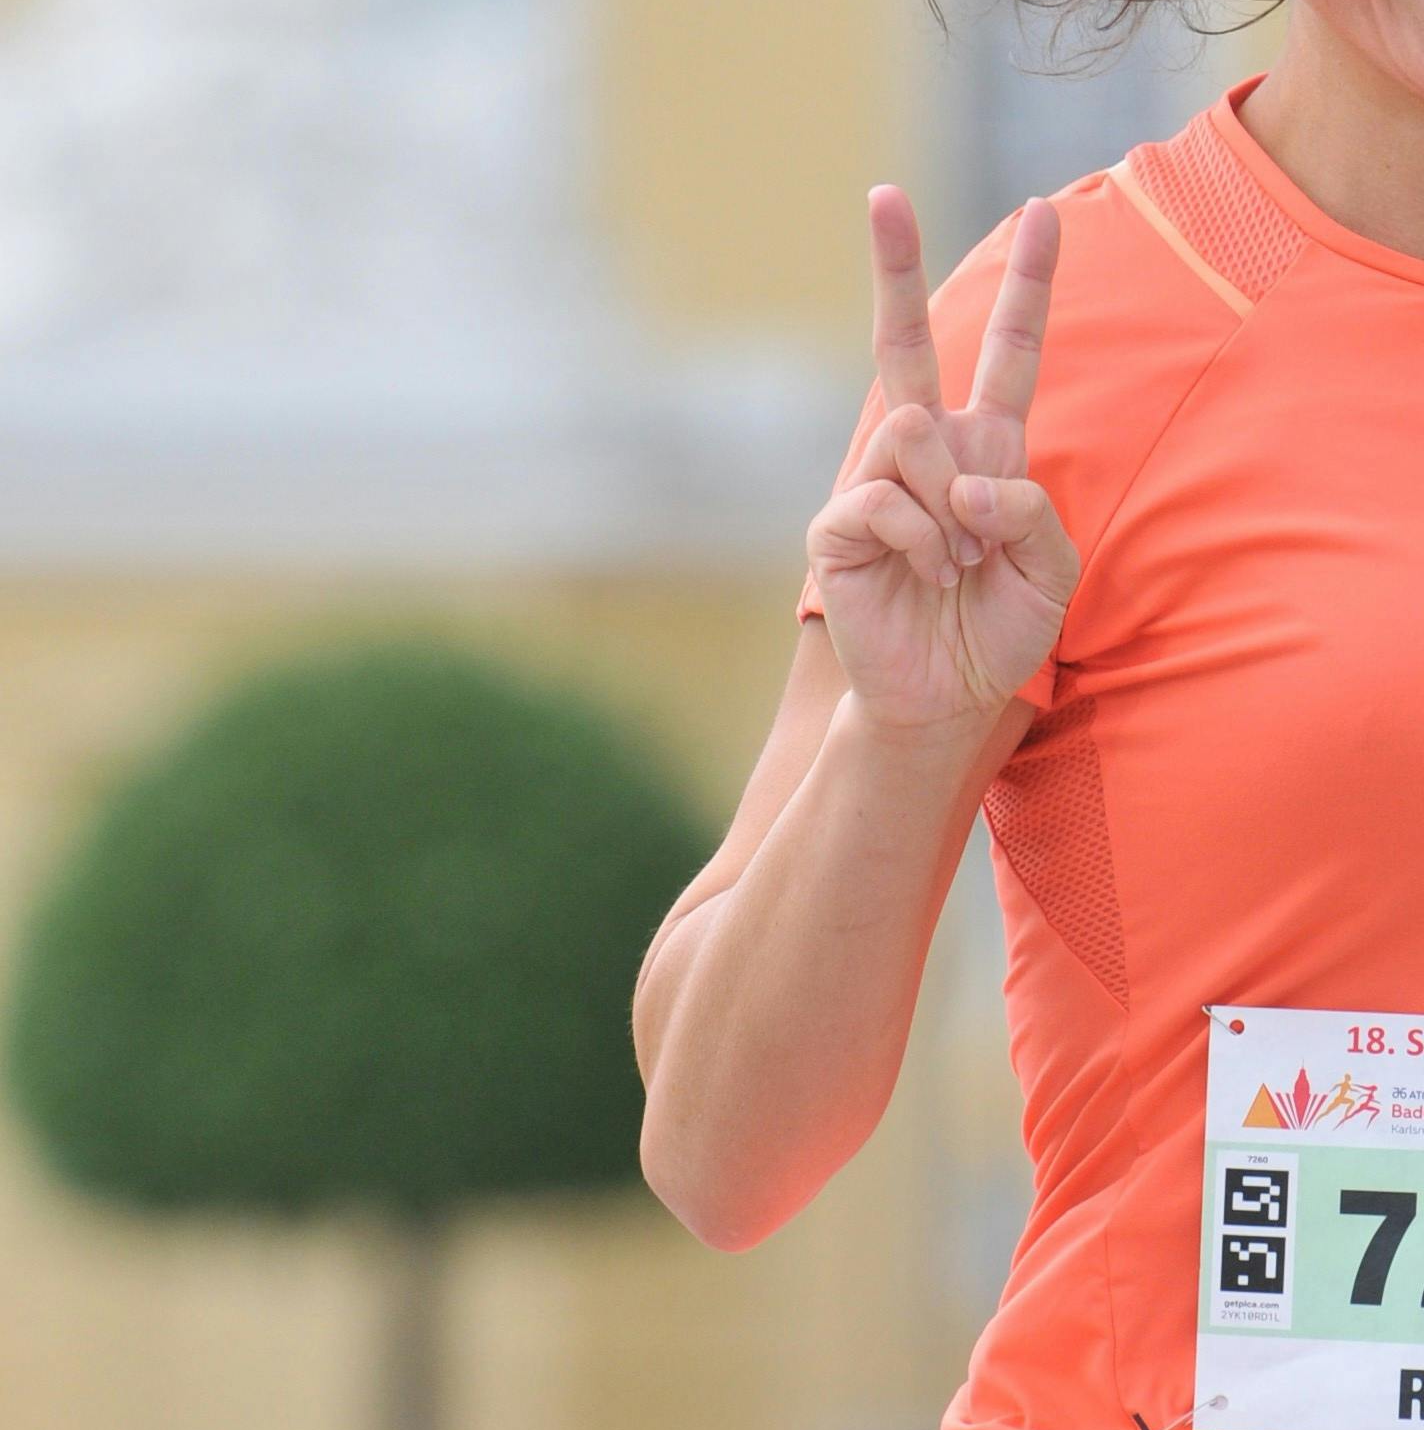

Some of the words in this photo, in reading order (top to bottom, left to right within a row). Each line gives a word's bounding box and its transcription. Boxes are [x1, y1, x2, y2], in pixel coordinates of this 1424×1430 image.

[1347, 1026, 1395, 1055] 18.
[1247, 1155, 1269, 1164] 7260
[1224, 1300, 1280, 1309] getpica.com
